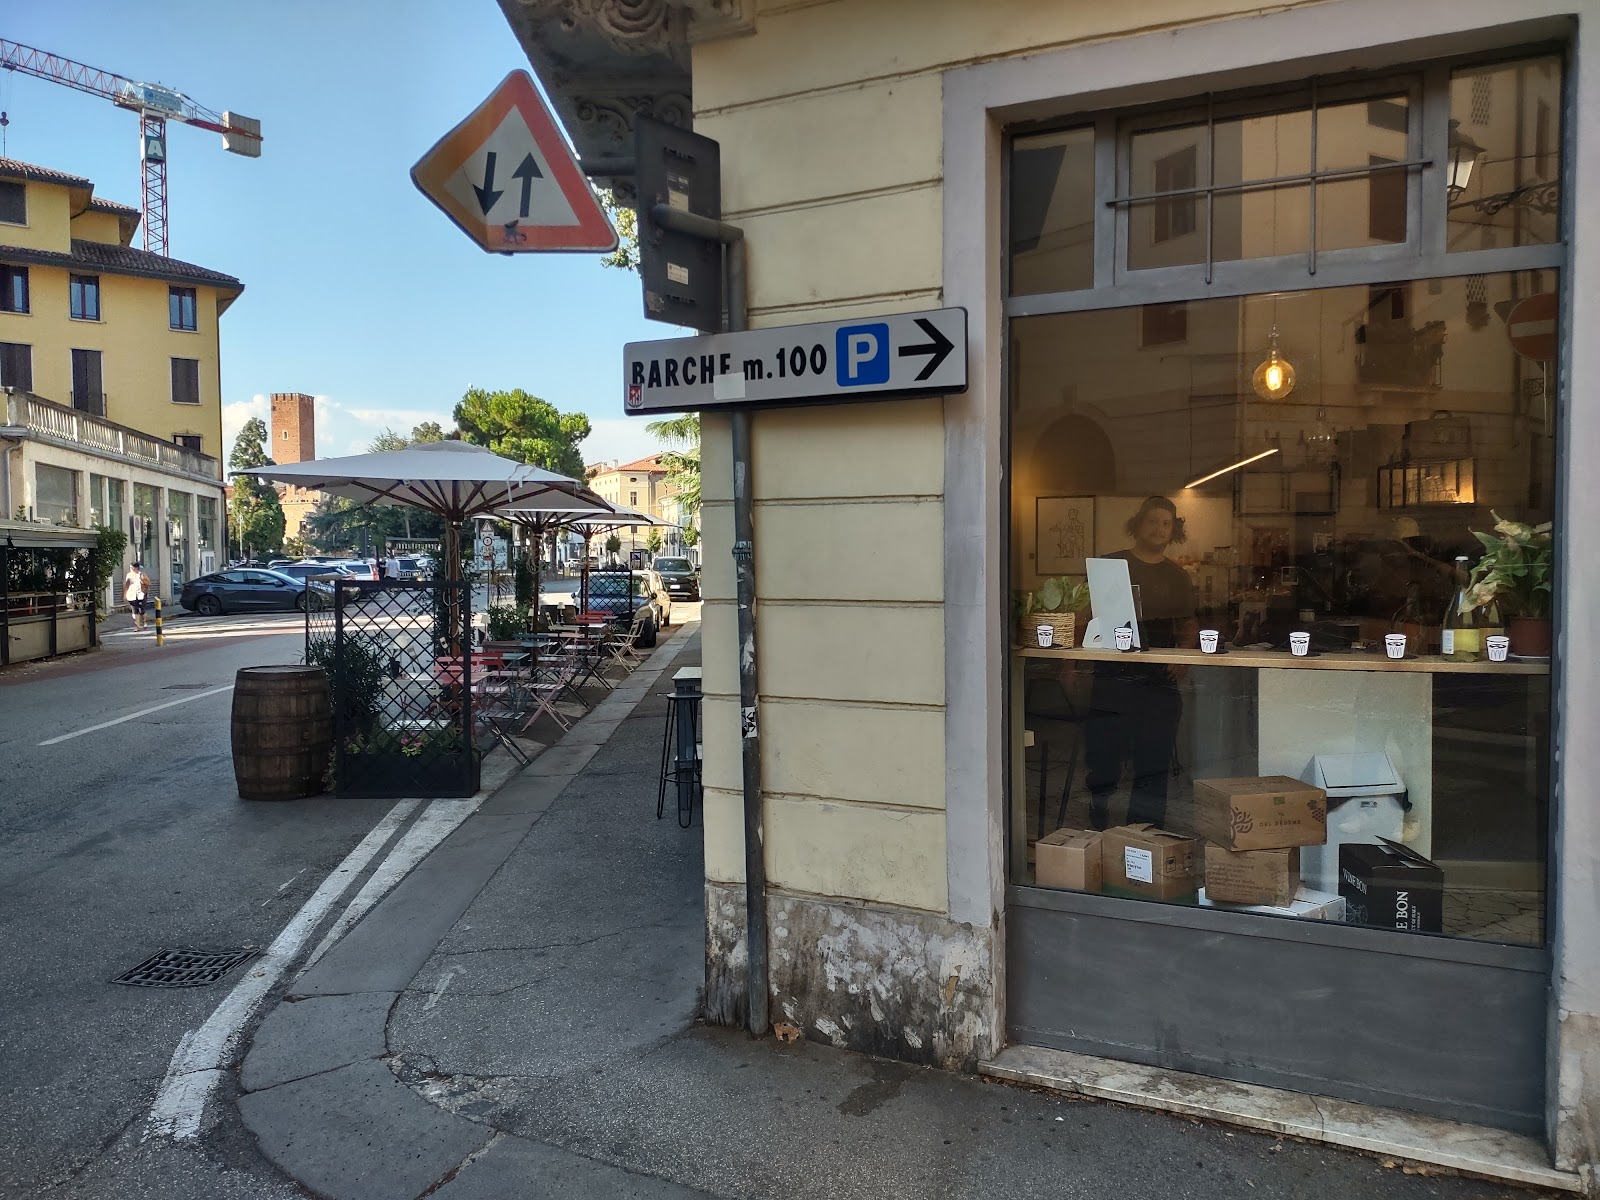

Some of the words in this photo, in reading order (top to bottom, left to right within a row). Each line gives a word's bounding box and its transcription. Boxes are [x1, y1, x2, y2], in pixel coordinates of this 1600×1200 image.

[148, 139, 164, 157] A
[743, 344, 827, 380] m.100
[848, 333, 879, 378] P
[1396, 891, 1408, 919] BON
